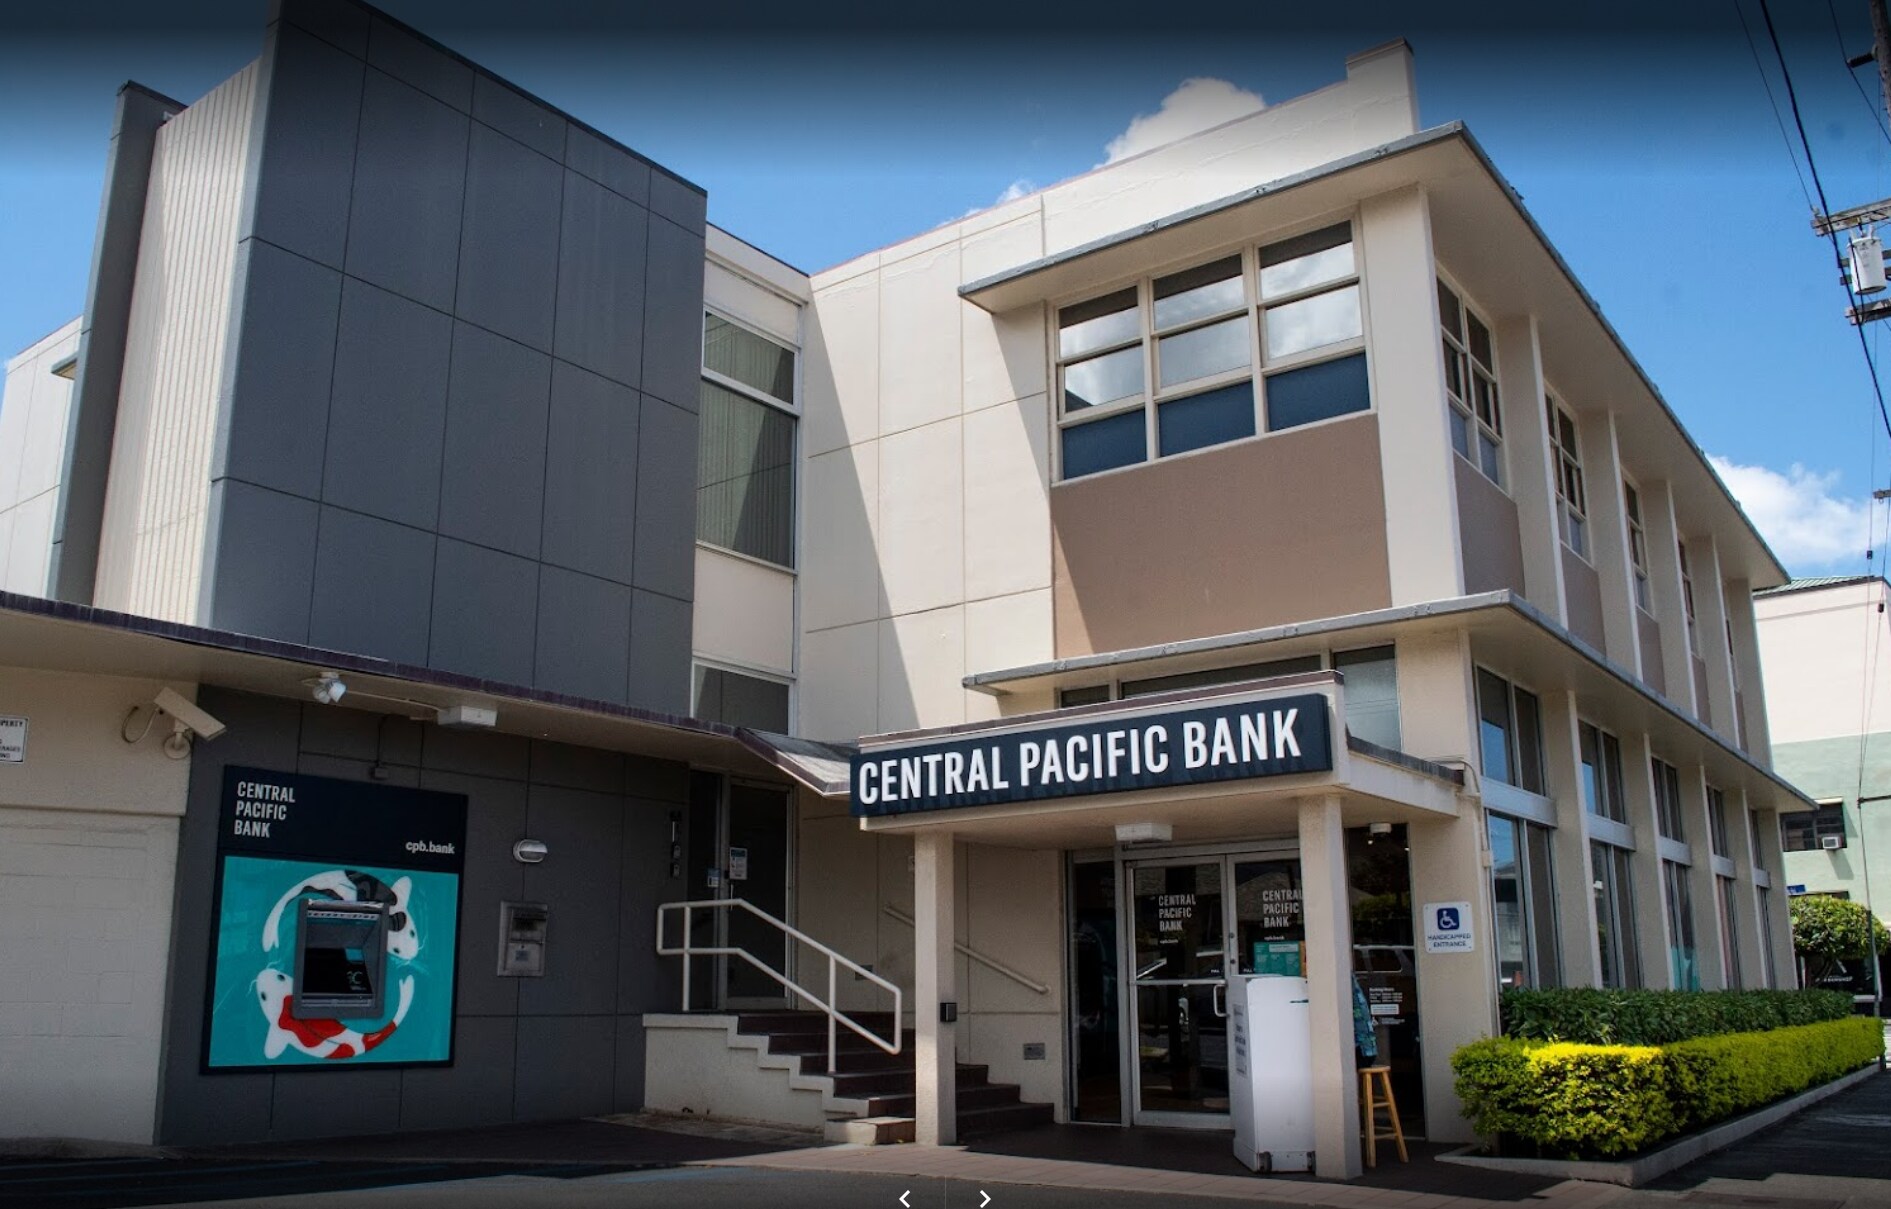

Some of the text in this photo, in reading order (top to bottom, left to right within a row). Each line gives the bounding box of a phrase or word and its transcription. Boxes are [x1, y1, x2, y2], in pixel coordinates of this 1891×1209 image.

[858, 708, 1302, 805] CENTRAL PACIFIC BANK
[237, 781, 296, 803] CENTRAL
[235, 800, 287, 821] PACIFIC
[234, 819, 271, 838] BANK
[405, 840, 455, 854] cpb.bank
[1158, 894, 1197, 907] CENTRAL
[1262, 888, 1303, 902] CENTRAL
[1158, 907, 1192, 919] PACIFIC
[1263, 902, 1300, 915] PACIFIC
[1159, 920, 1183, 932] BANK
[1263, 916, 1289, 928] BANK
[1433, 940, 1467, 948] ENTRANCE
